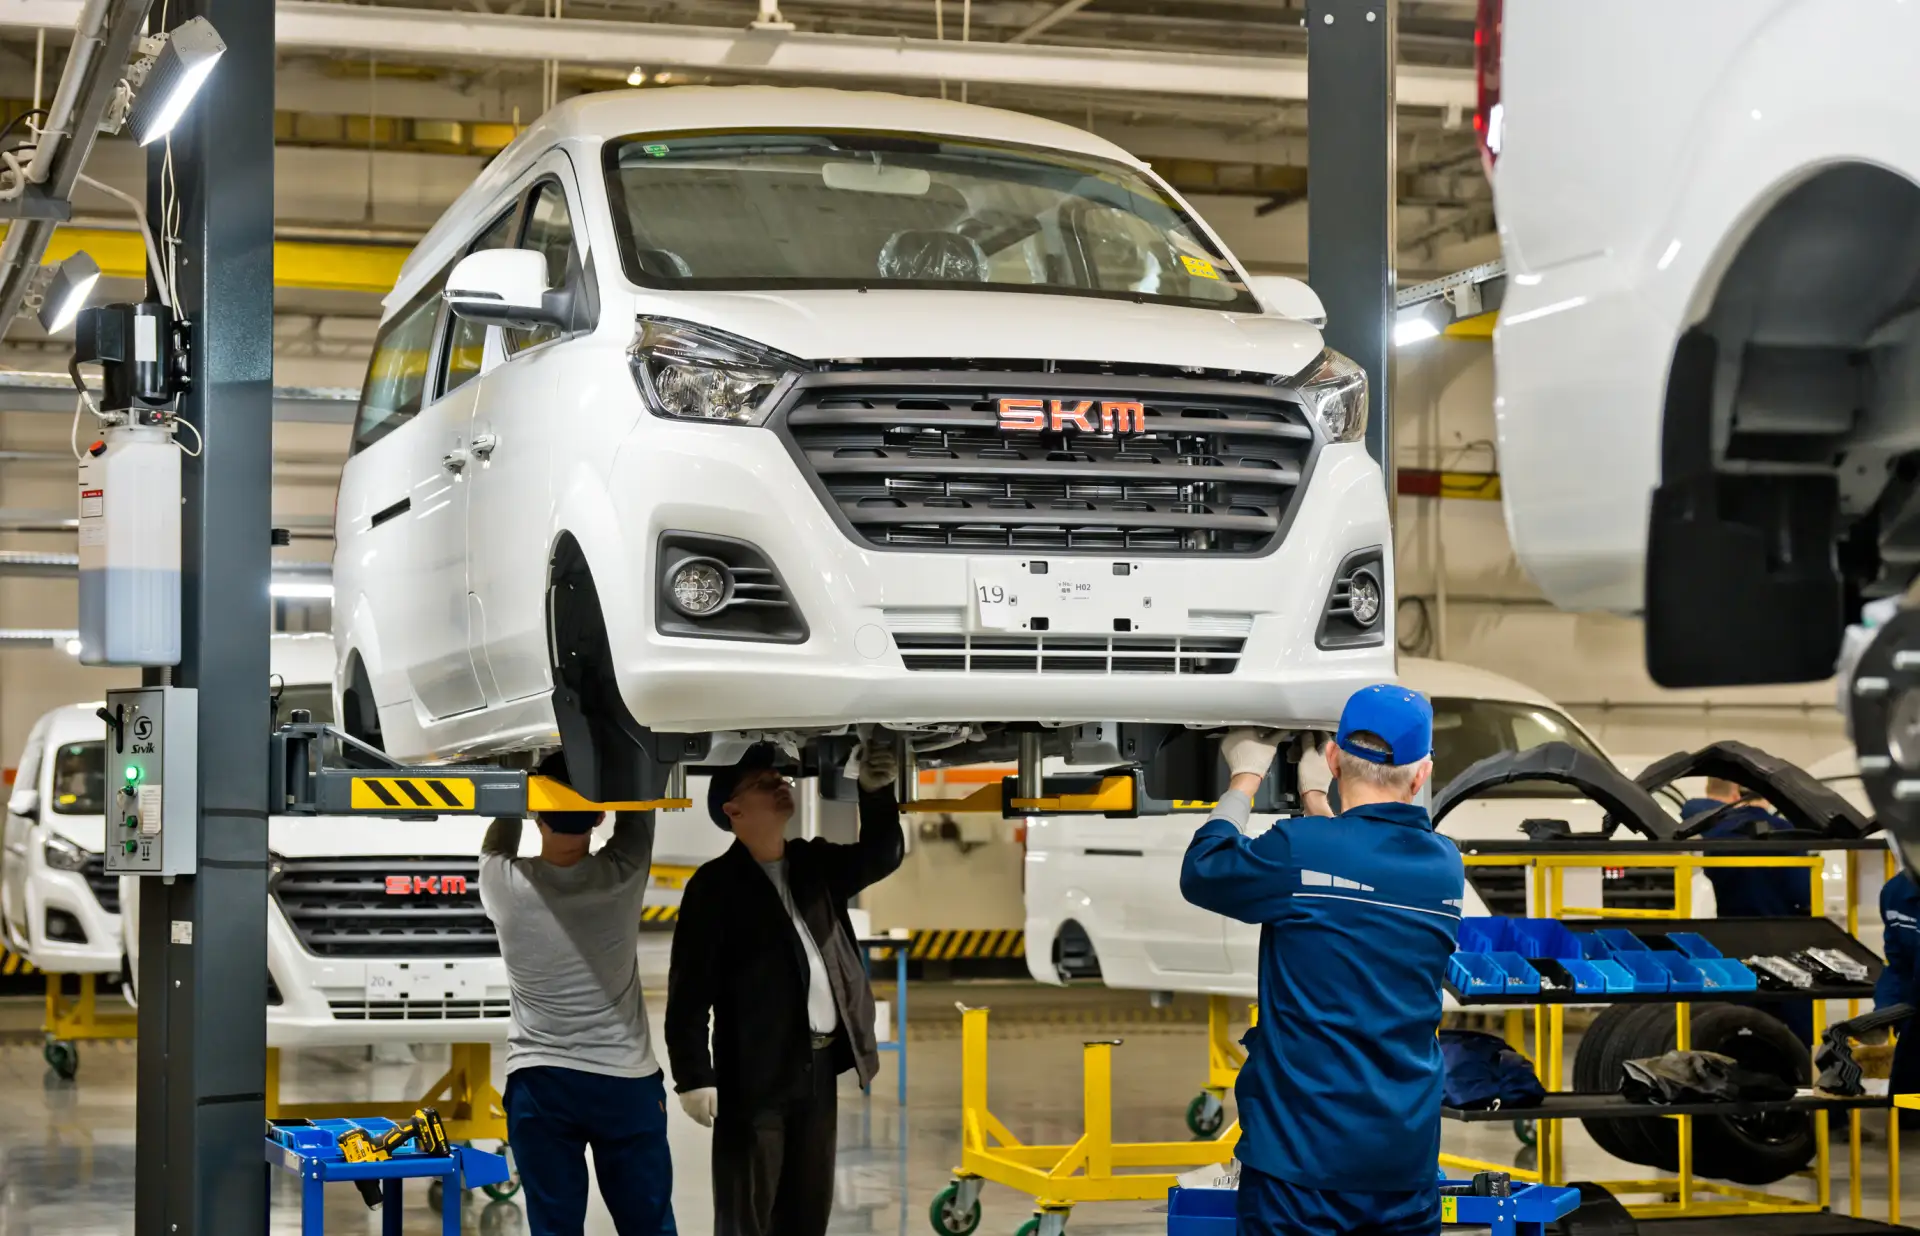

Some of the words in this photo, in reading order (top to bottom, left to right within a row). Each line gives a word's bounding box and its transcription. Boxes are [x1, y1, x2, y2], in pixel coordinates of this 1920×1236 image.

[998, 398, 1145, 432] SKM
[979, 585, 1004, 604] 19
[1075, 583, 1091, 591] H02
[385, 875, 466, 895] SKM
[370, 975, 386, 987] 20
